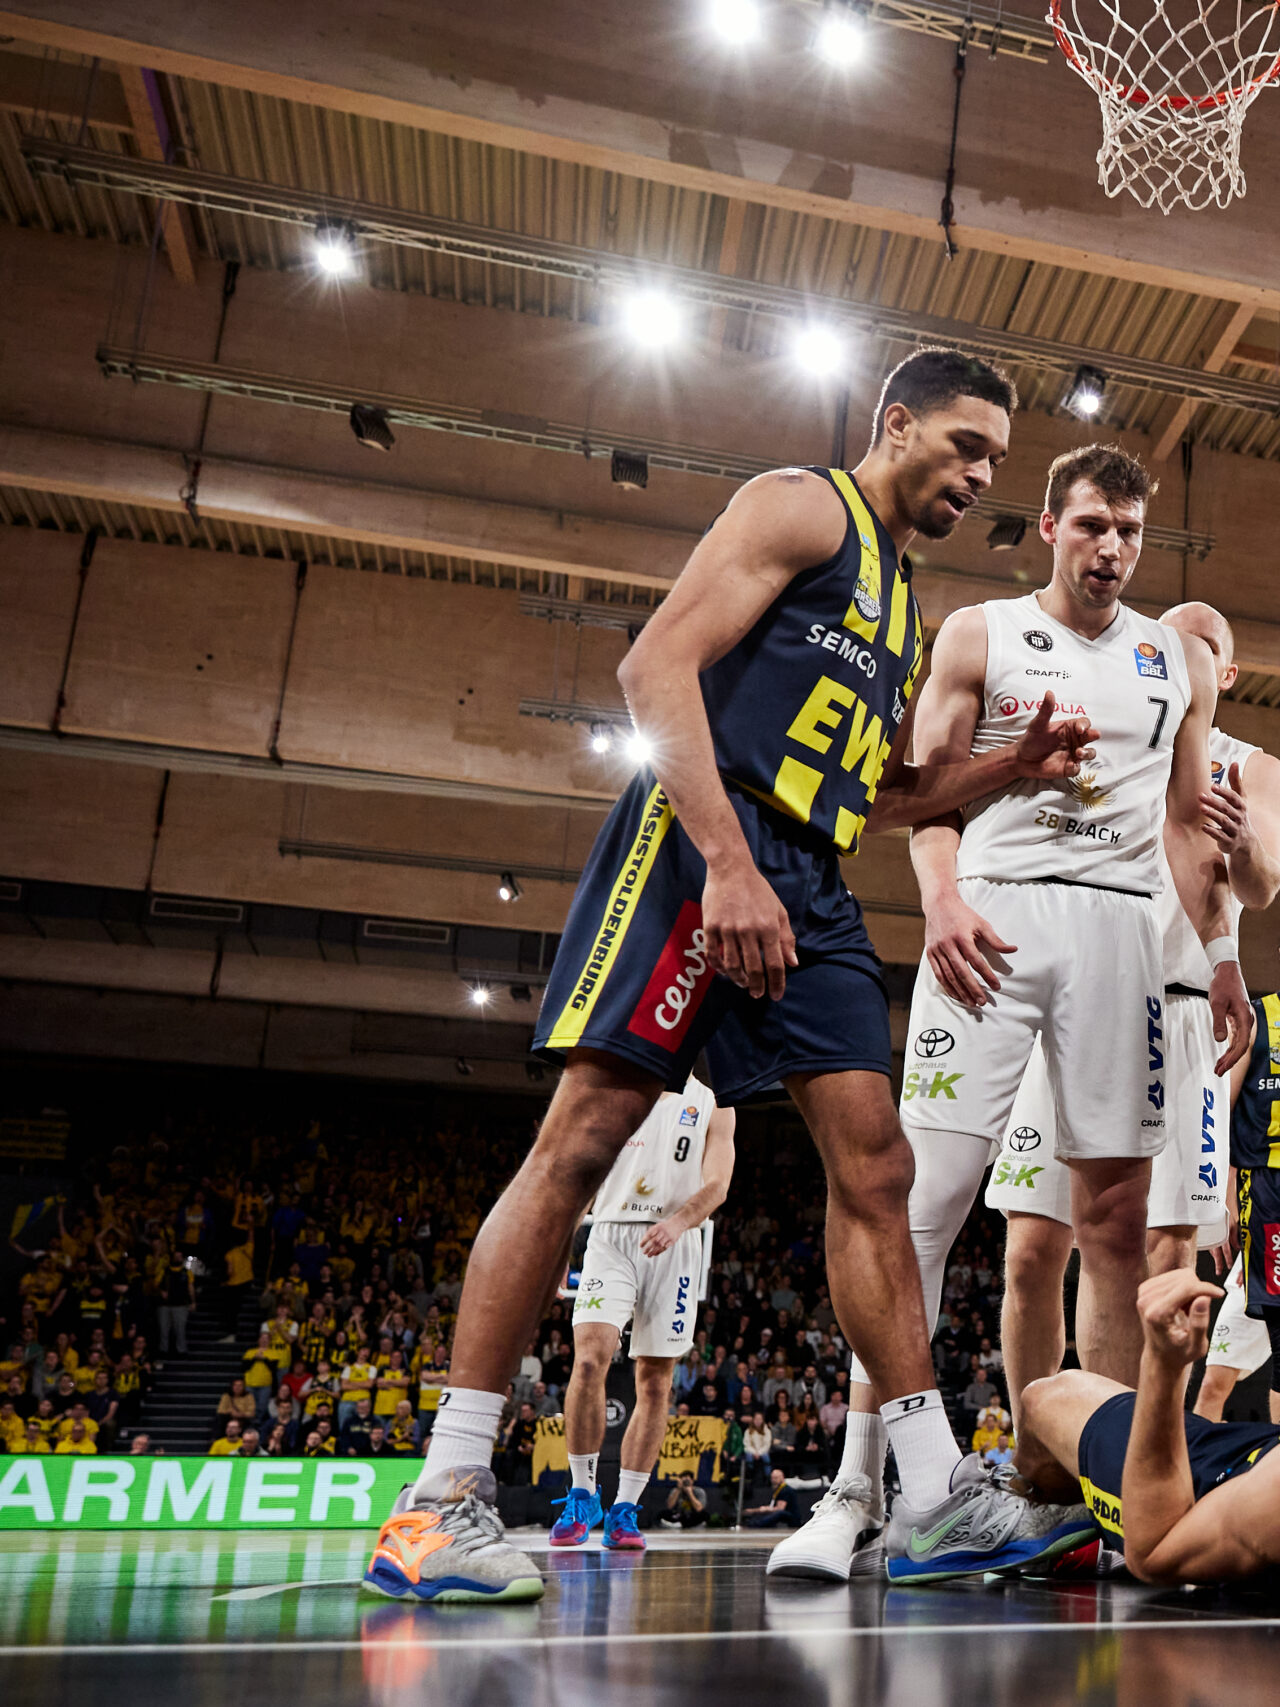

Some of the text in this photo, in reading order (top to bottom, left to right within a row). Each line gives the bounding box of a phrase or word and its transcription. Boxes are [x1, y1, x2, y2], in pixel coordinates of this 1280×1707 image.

[805, 623, 877, 679] SEMCO
[1025, 669, 1061, 678] CRAFT
[1140, 667, 1165, 678] BBL
[1147, 695, 1170, 750] 7
[1034, 810, 1122, 845] 28 BLACK
[1146, 995, 1164, 1072] VTG
[903, 1071, 966, 1102] S+K
[1141, 1120, 1163, 1128] CRAFT
[1201, 1087, 1216, 1153] VTG
[674, 1136, 691, 1163] 9
[993, 1161, 1046, 1189] S+K
[631, 1203, 663, 1215] BLACK
[1191, 1194, 1217, 1202] CRAFT
[674, 1276, 690, 1315] VTG
[0, 1459, 377, 1522] ARMER
